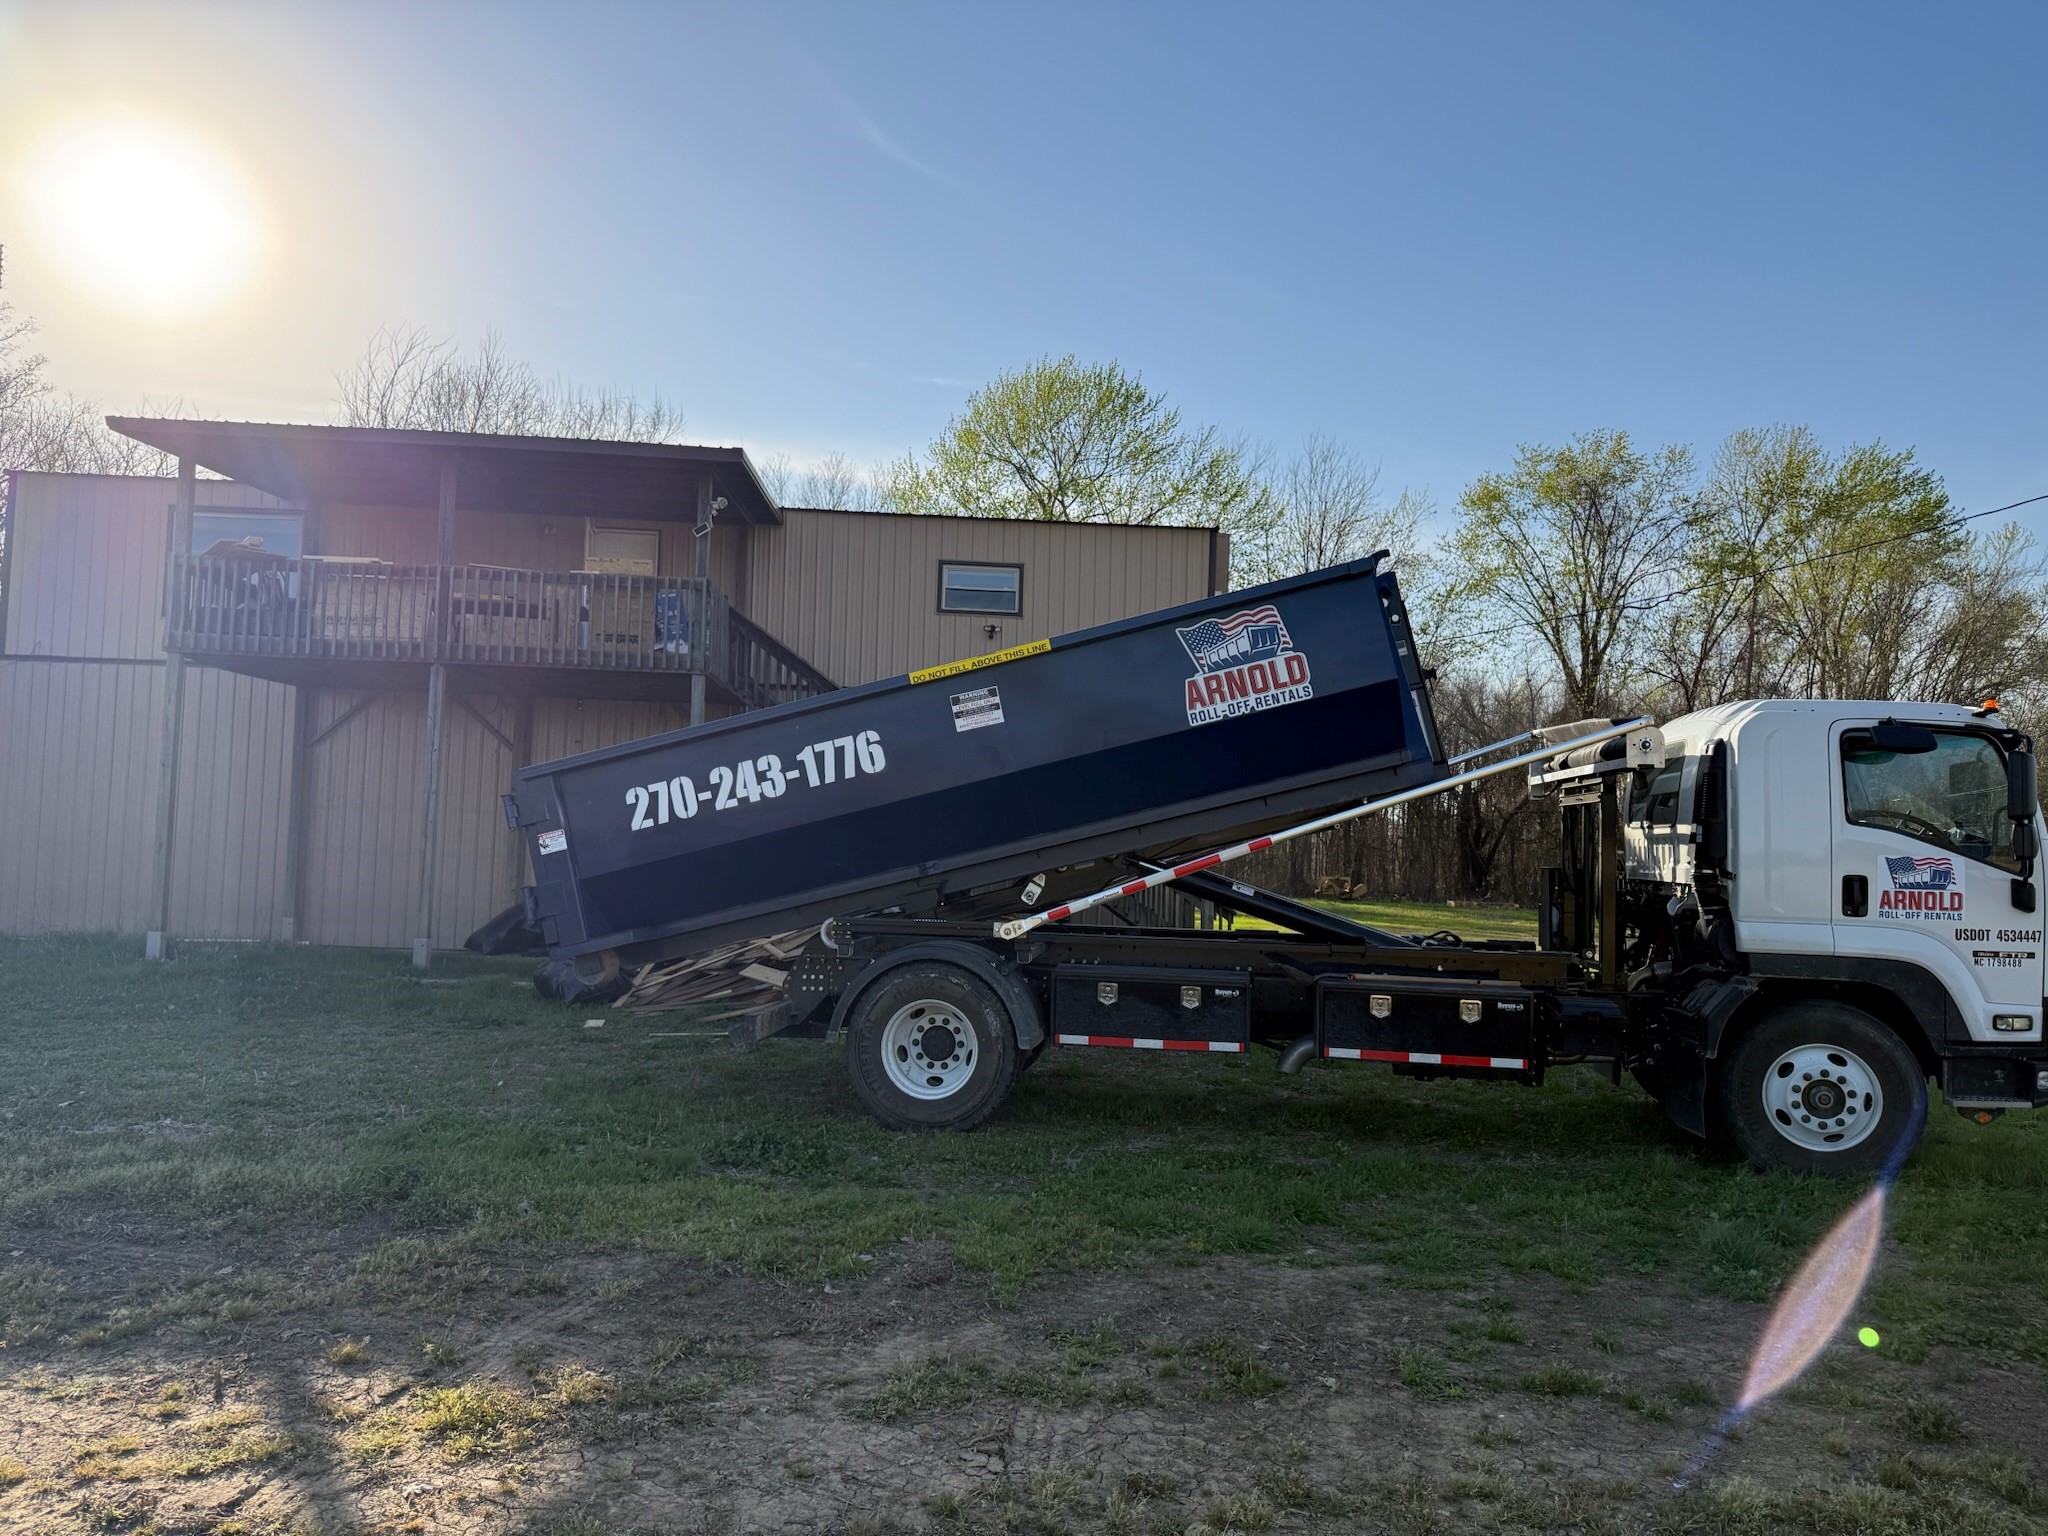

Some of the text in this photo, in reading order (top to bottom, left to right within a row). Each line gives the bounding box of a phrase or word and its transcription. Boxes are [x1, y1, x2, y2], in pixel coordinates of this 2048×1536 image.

[912, 643, 1048, 683] DO NOT FILL ABOVE THIS LINE
[1187, 654, 1309, 711] ARNOLD
[958, 689, 989, 700] WARNING
[1190, 686, 1311, 724] ROLL-OFF RENTALS
[625, 730, 887, 831] 270-243-1776
[1879, 890, 1963, 912] ARNOLD
[1879, 911, 1963, 921] ROLL-OFF RENTALS
[1955, 928, 2042, 943] USDOT 4534447
[1974, 958, 2022, 968] MC 1798488
